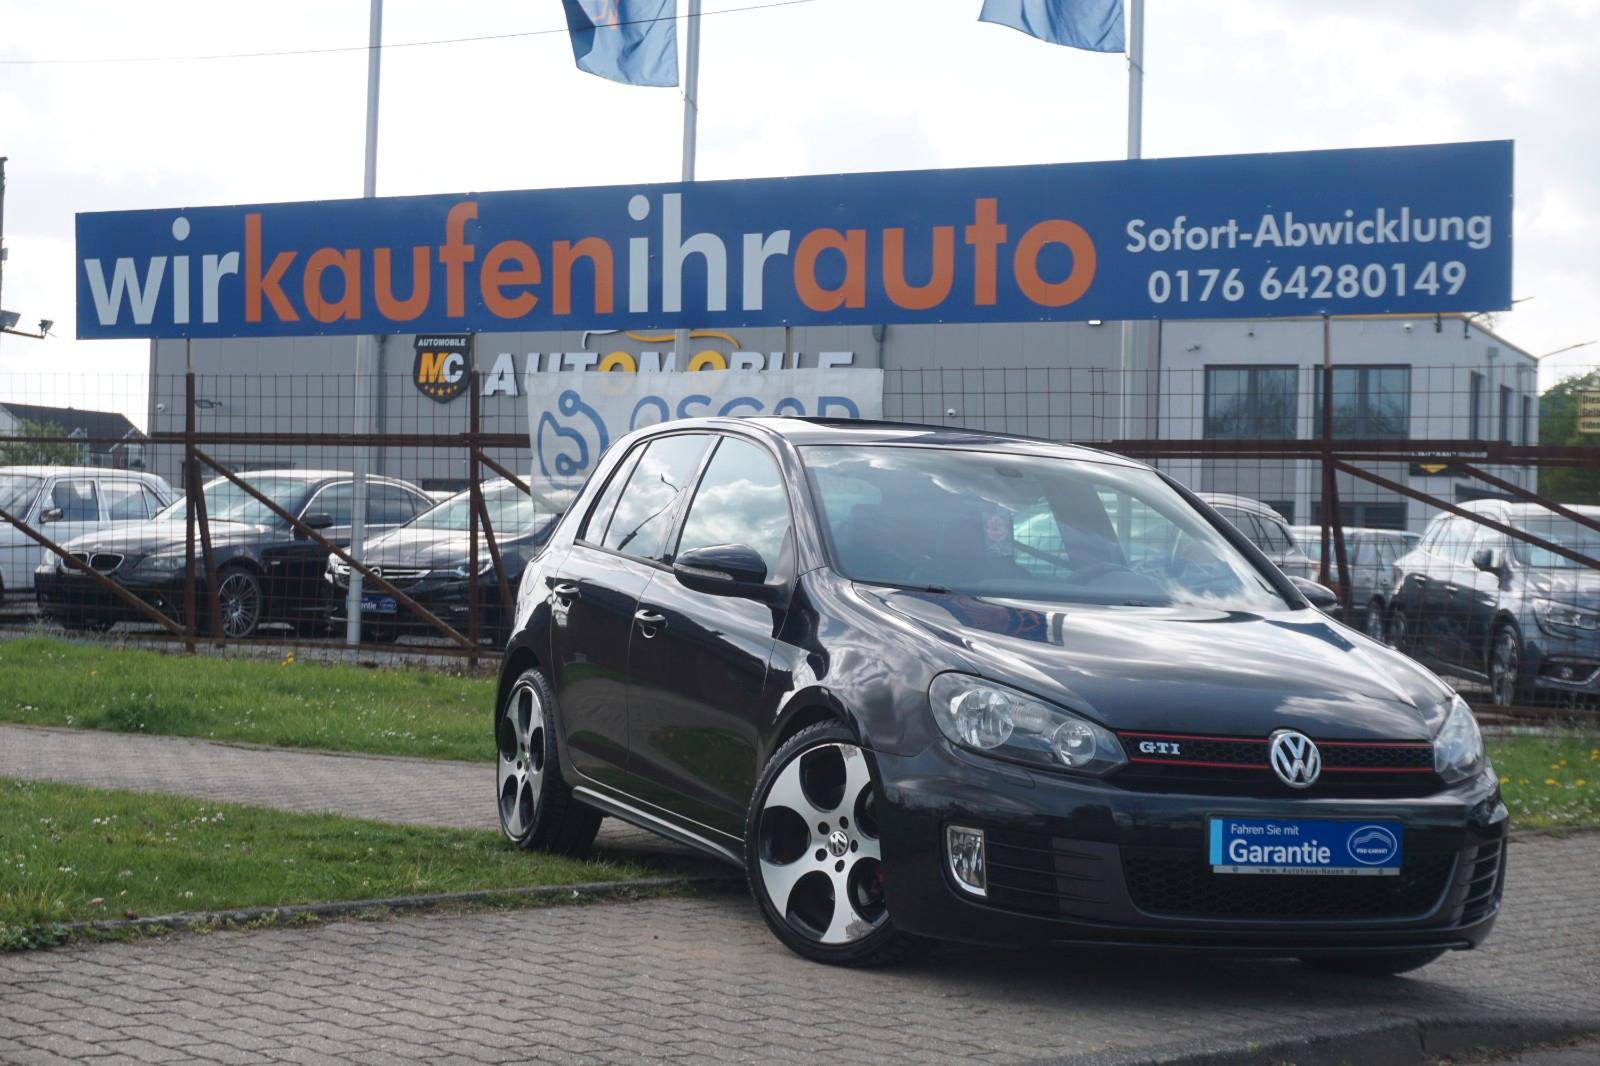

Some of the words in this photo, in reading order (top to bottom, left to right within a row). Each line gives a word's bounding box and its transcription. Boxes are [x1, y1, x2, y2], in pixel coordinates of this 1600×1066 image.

[1126, 207, 1492, 252] Sofort-Abwicklung
[1148, 268, 1245, 304] 0176
[1259, 260, 1467, 301] 64280149
[418, 338, 466, 347] AUTOMOBILE
[418, 352, 465, 384] MC
[1139, 741, 1181, 755] GTI
[1230, 824, 1264, 835] Fahren
[1266, 825, 1282, 836] Sie
[1284, 826, 1299, 836] mit
[1229, 838, 1331, 864] Garantie
